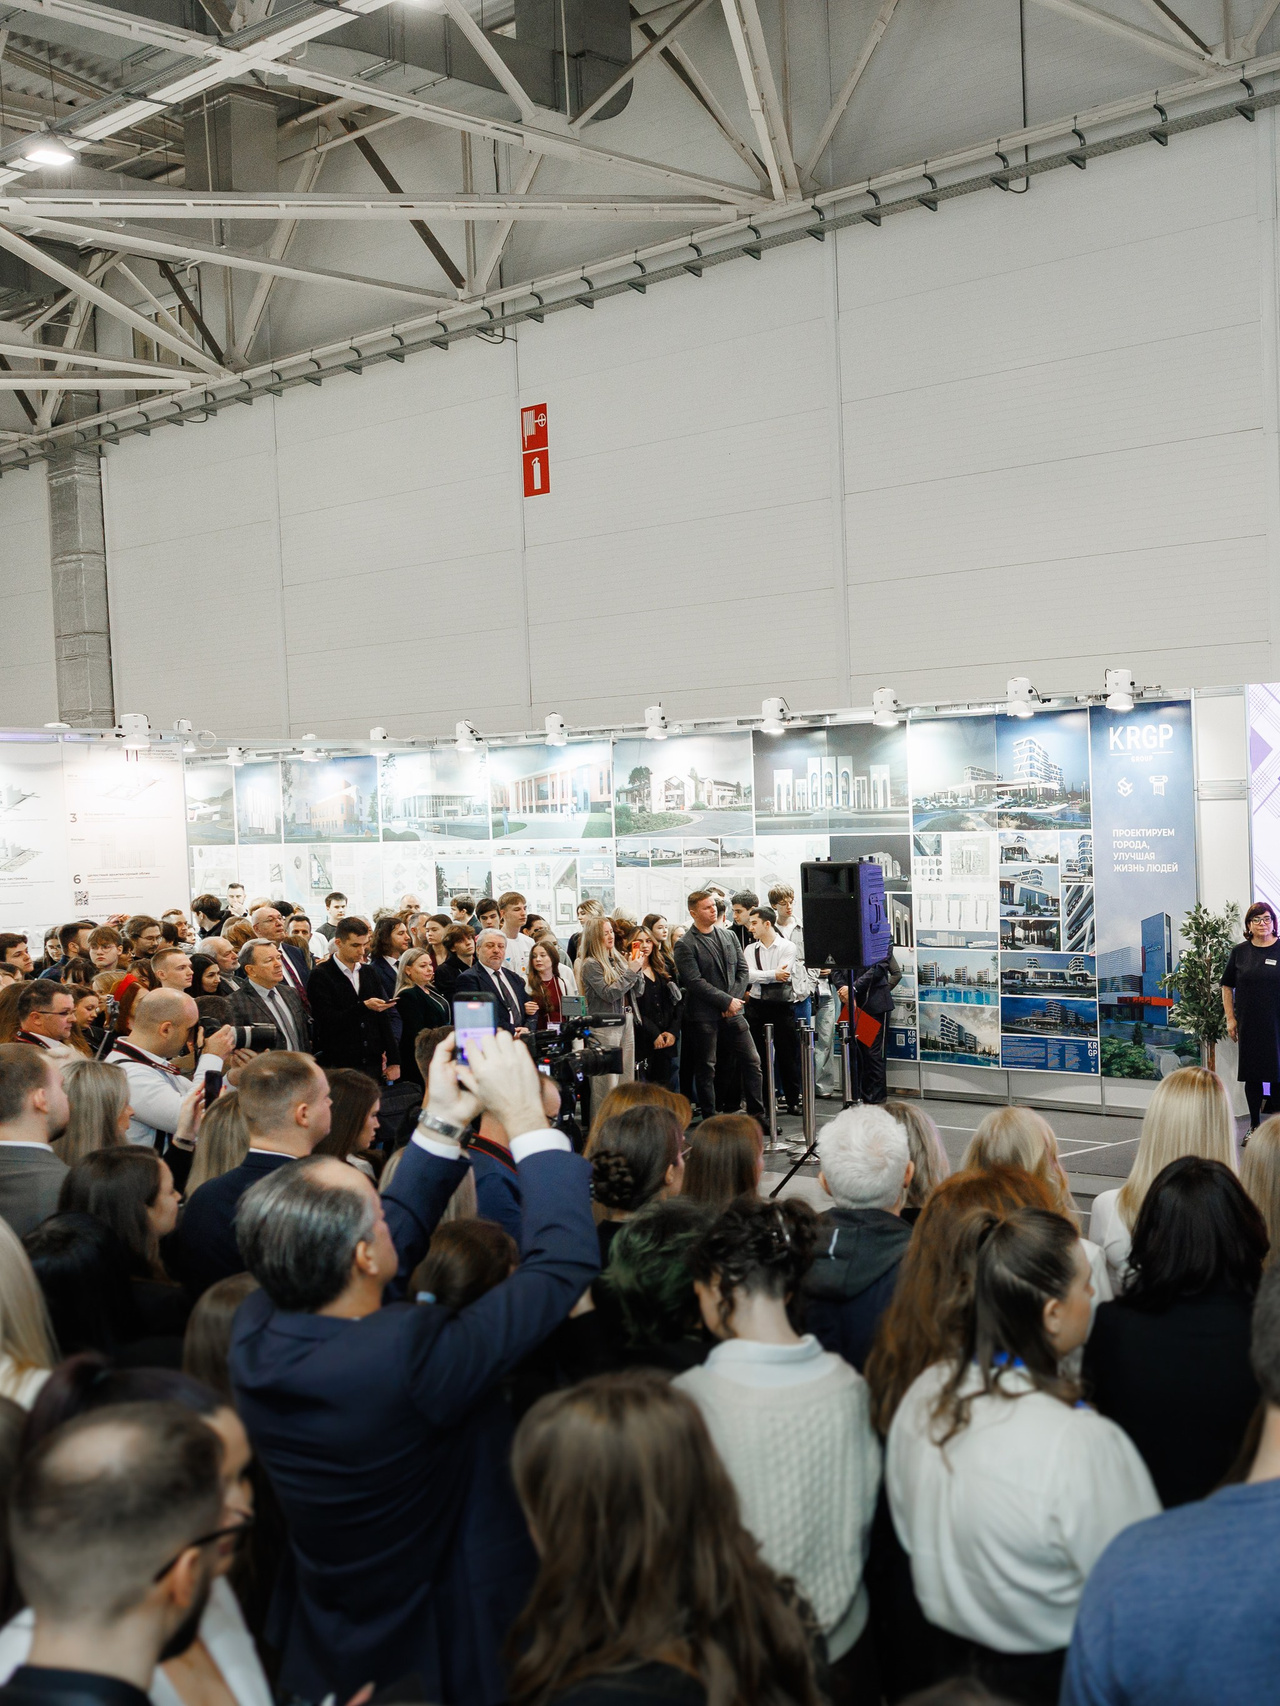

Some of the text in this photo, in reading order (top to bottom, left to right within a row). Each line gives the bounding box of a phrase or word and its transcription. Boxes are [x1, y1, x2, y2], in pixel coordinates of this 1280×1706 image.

[1109, 724, 1174, 751] KRGP
[1131, 755, 1154, 763] GROUP
[69, 812, 78, 823] 3
[1112, 828, 1175, 838] ПРОЕКТИРУЕМ
[1113, 841, 1150, 850] ГОРОДА,
[1113, 852, 1155, 861] УЛУЧШАЯ
[1113, 862, 1178, 873] ЖИЗНЬ ЛЮДЕЙ
[73, 874, 82, 885] 6
[1087, 1041, 1098, 1049] KR
